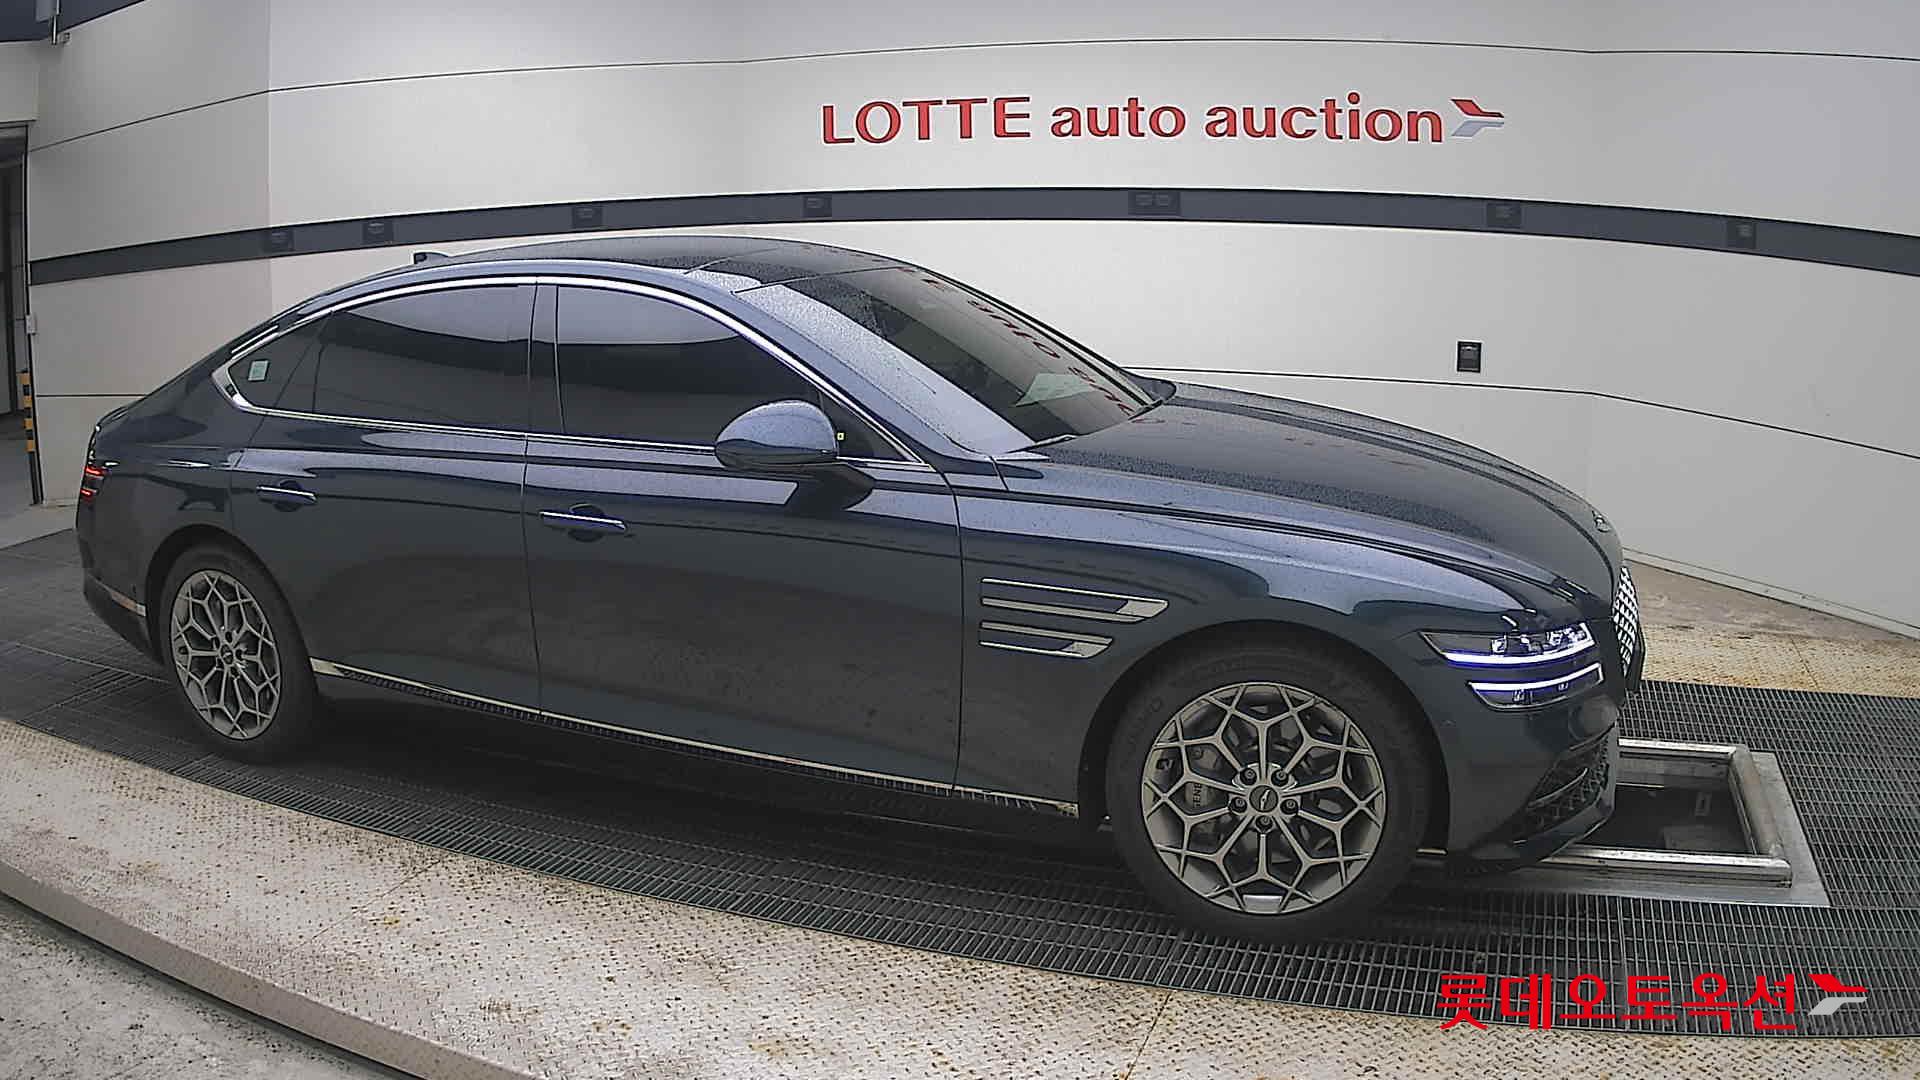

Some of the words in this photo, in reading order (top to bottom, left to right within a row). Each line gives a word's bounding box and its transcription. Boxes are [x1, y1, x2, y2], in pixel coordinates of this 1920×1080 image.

[822, 96, 1031, 145] LOTTE
[1050, 97, 1187, 139] auto
[1205, 92, 1443, 143] auction
